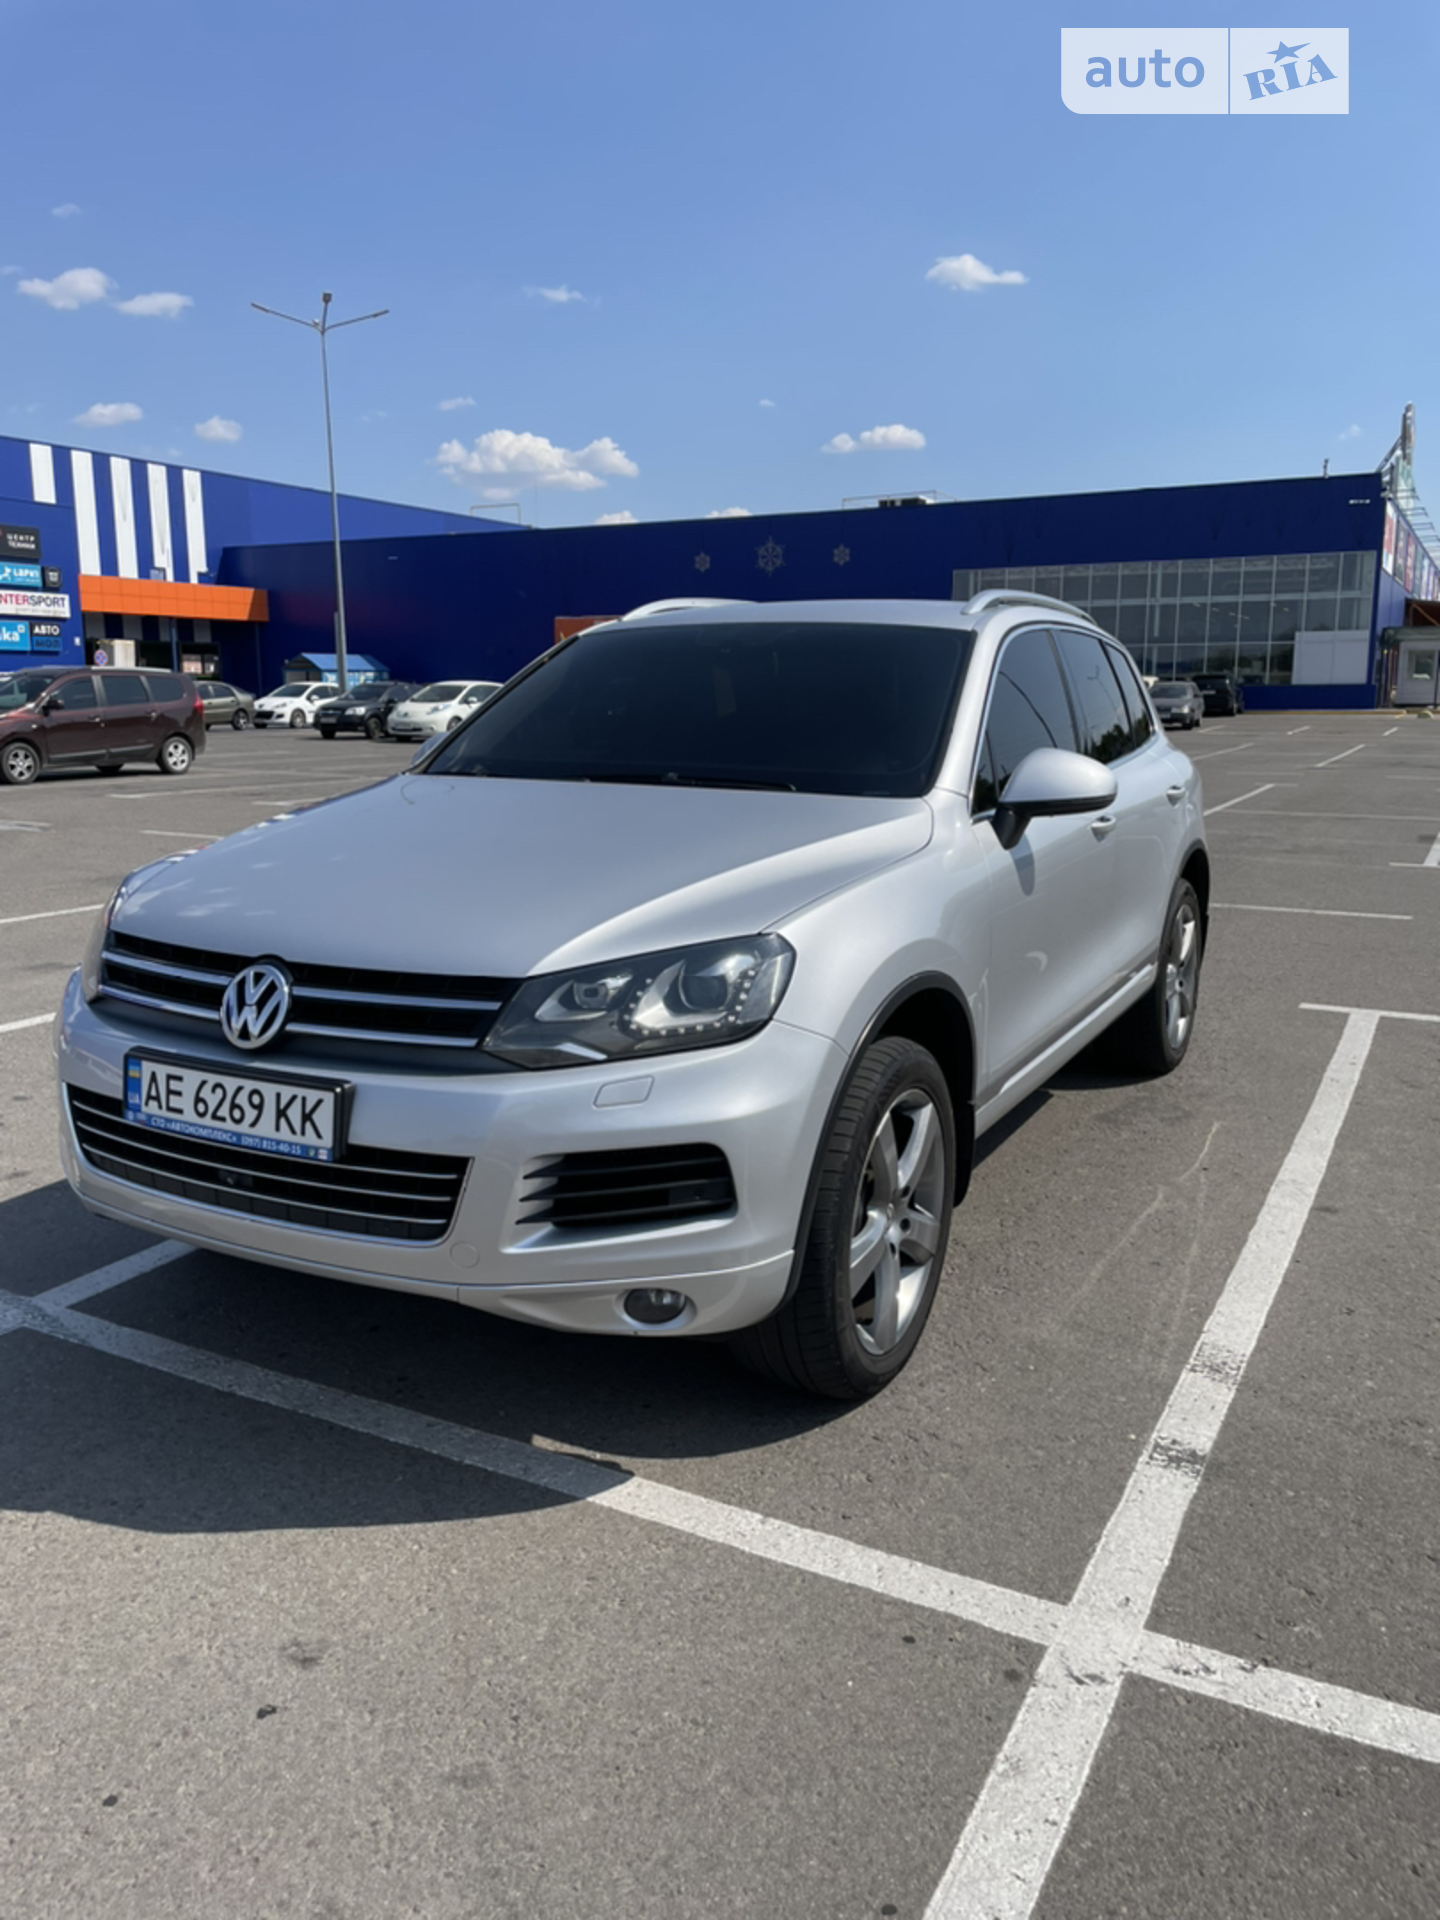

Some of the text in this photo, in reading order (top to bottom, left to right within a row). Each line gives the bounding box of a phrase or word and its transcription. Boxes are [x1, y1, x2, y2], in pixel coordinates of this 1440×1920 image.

[144, 1071, 325, 1140] AE 6269 KK
